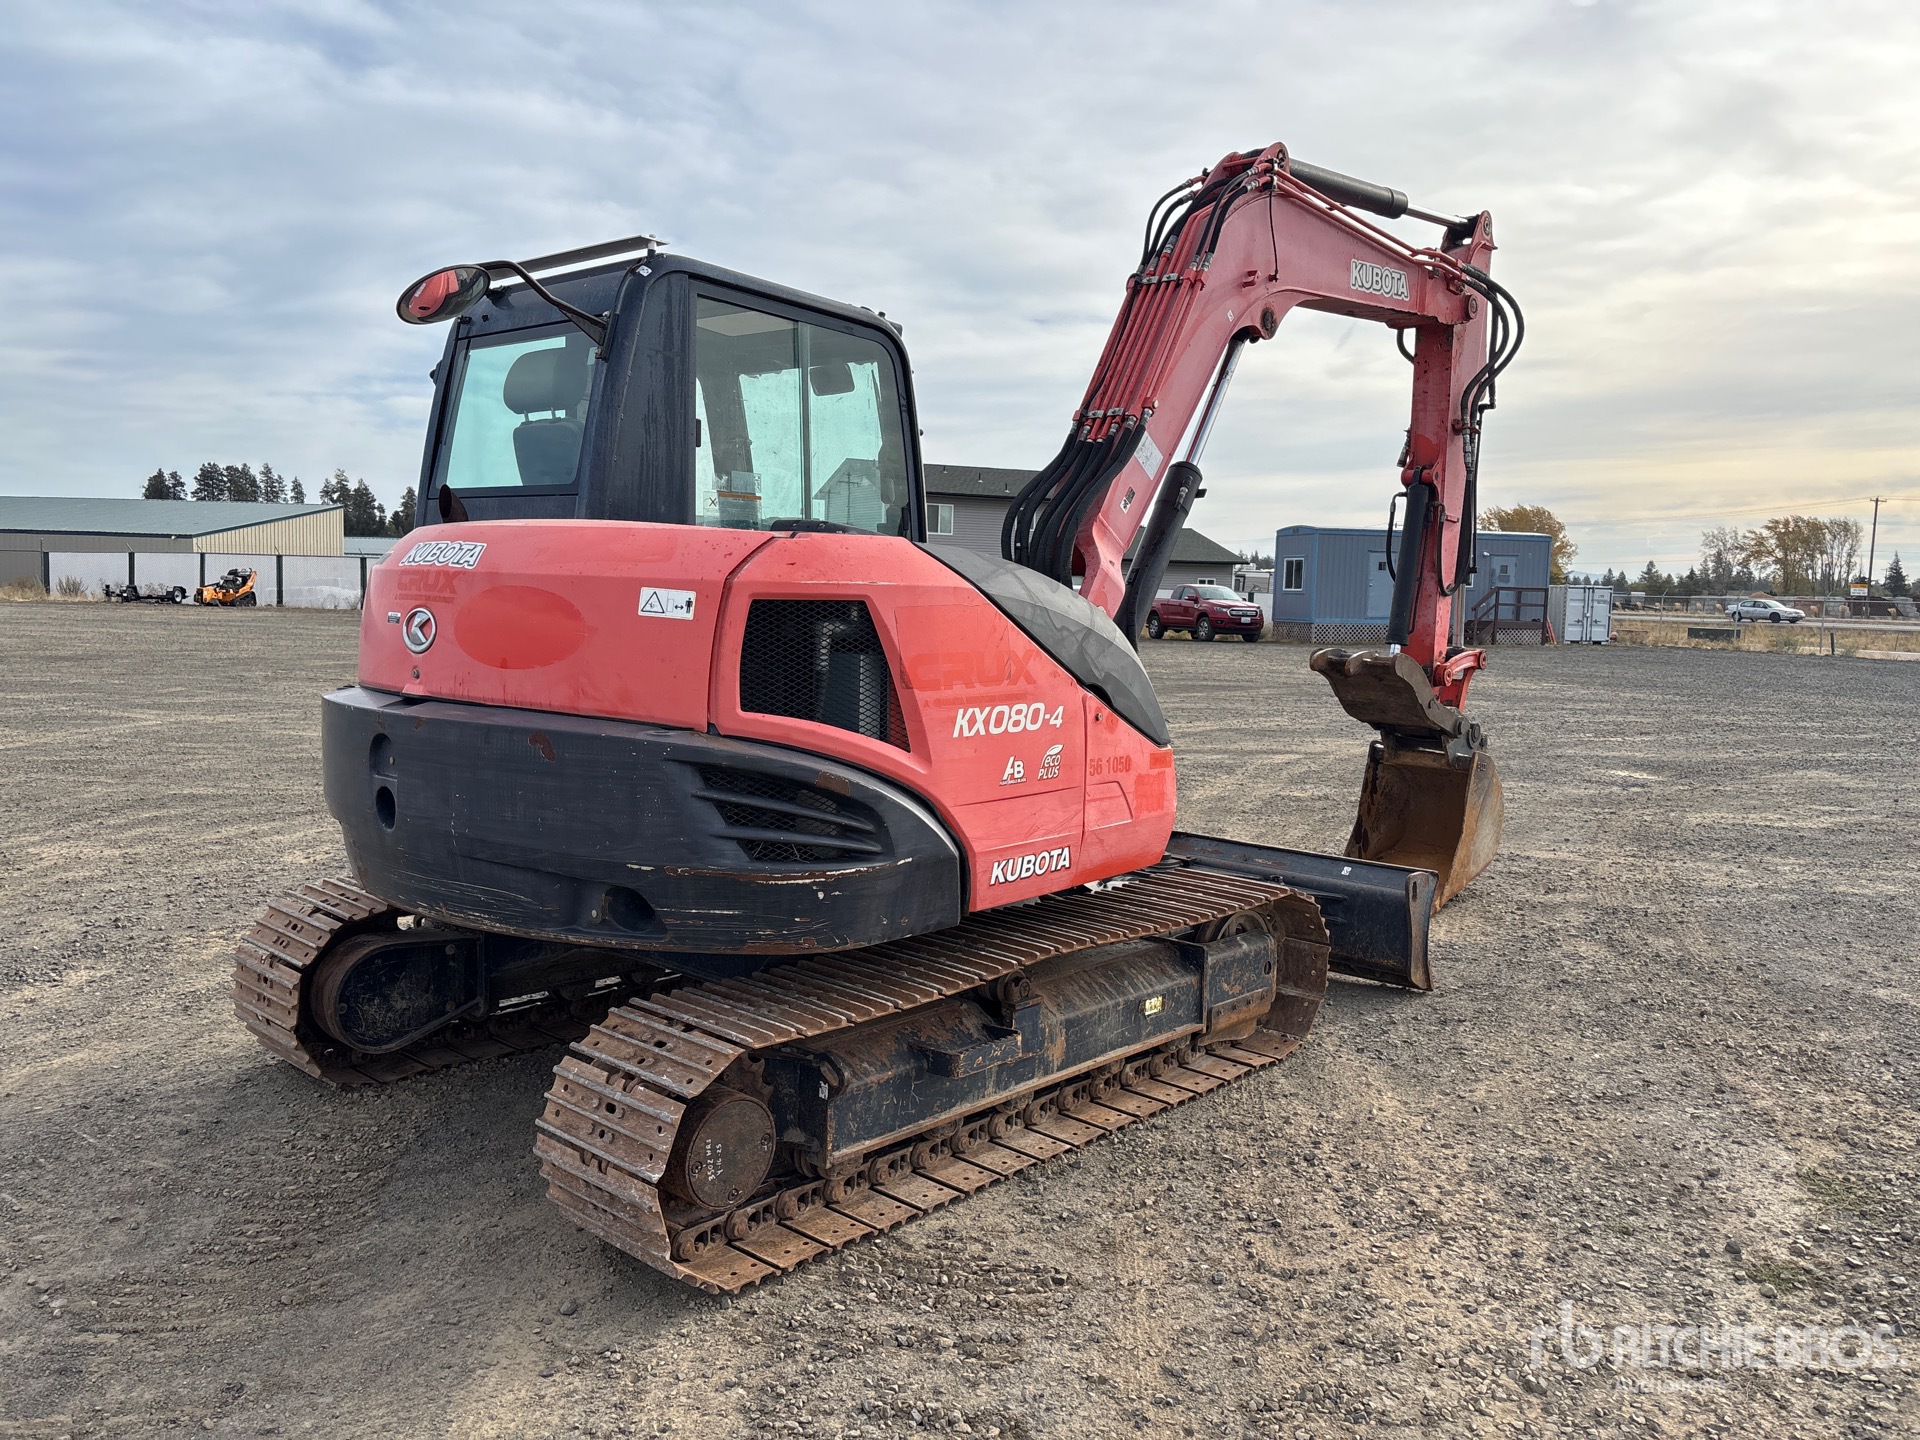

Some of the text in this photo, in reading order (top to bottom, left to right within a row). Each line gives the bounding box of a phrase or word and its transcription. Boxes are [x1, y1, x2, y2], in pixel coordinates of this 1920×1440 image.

[1351, 259, 1409, 300] KUBOTA
[400, 541, 486, 569] KUBOTA
[908, 648, 1037, 692] CRUX
[952, 702, 1064, 738] KX080-4
[1037, 766, 1060, 780] PLUS
[989, 846, 1072, 886] KUBOTA
